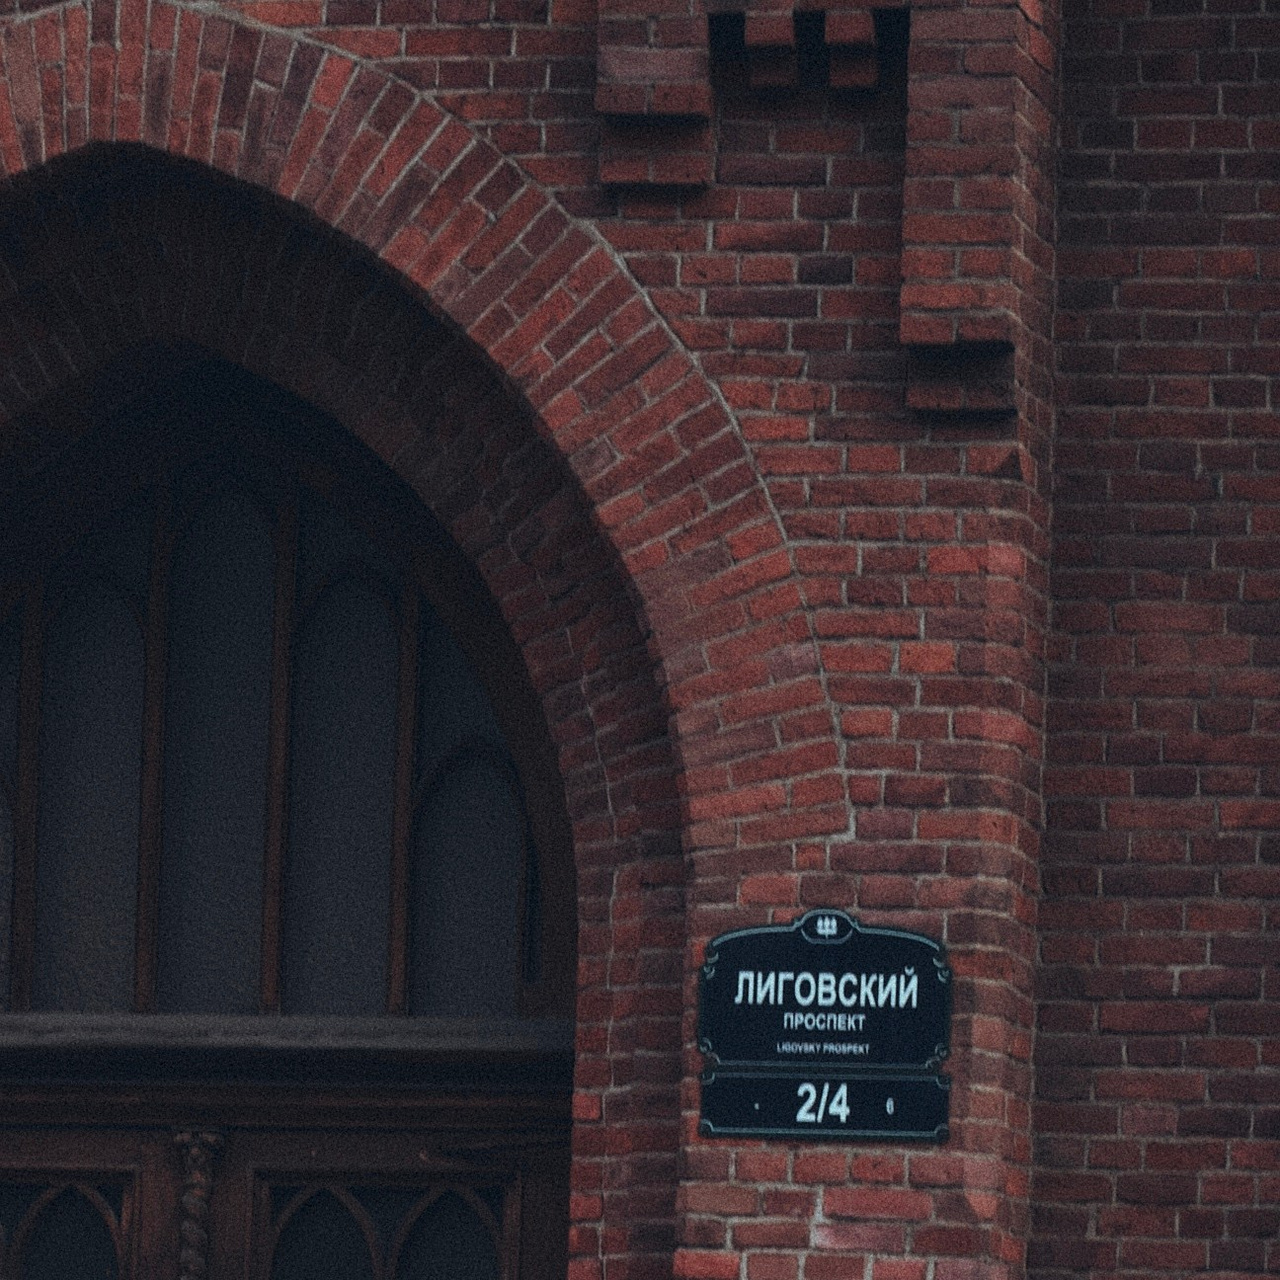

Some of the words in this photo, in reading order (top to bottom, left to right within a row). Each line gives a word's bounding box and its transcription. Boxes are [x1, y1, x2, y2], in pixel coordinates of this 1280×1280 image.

[734, 966, 919, 1009] ЛИГОВСКИЙ
[783, 1012, 866, 1032] ПРОСПЕКТ
[776, 1041, 821, 1054] LIGOVSKY
[823, 1042, 870, 1055] PROSPEKT
[795, 1082, 851, 1124] 2/4
